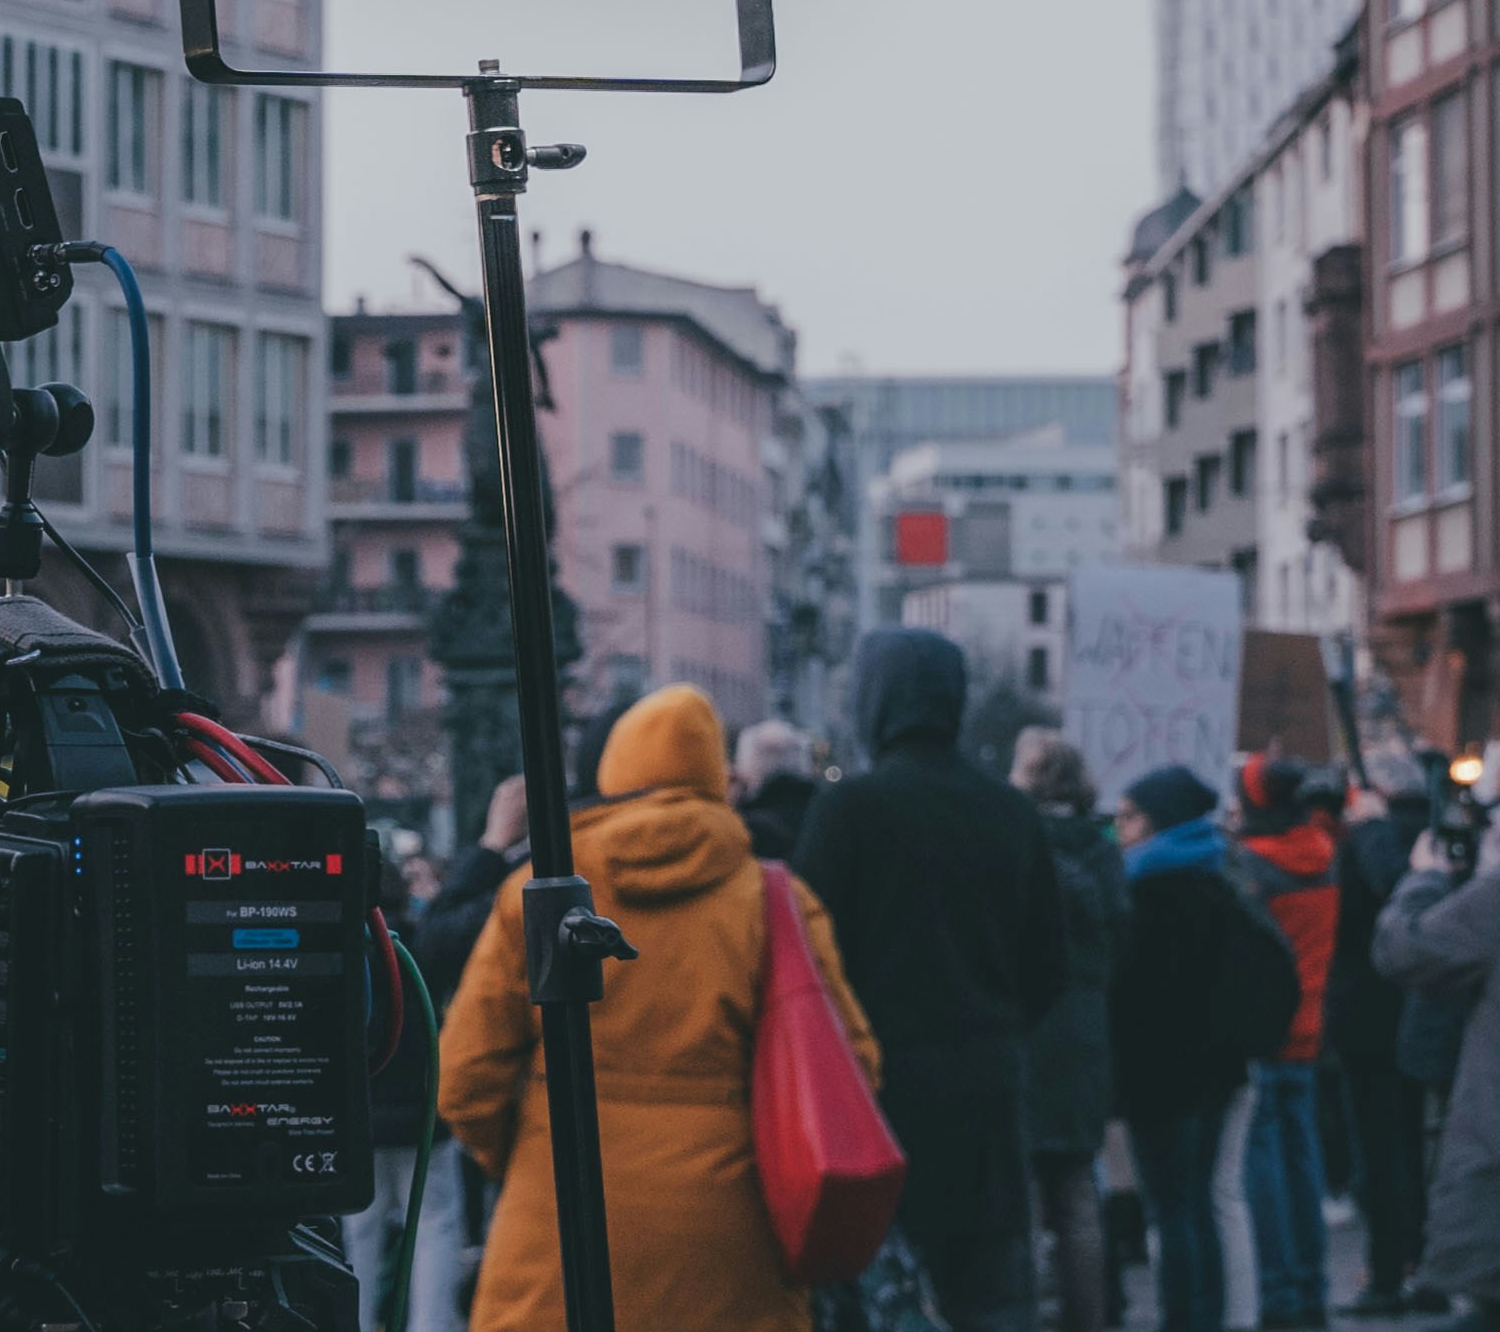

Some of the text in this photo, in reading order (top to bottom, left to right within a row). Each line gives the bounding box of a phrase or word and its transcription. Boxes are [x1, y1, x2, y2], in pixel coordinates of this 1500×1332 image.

[239, 906, 298, 918] BP-190WS
[236, 958, 299, 971] Li-ion 14.4V
